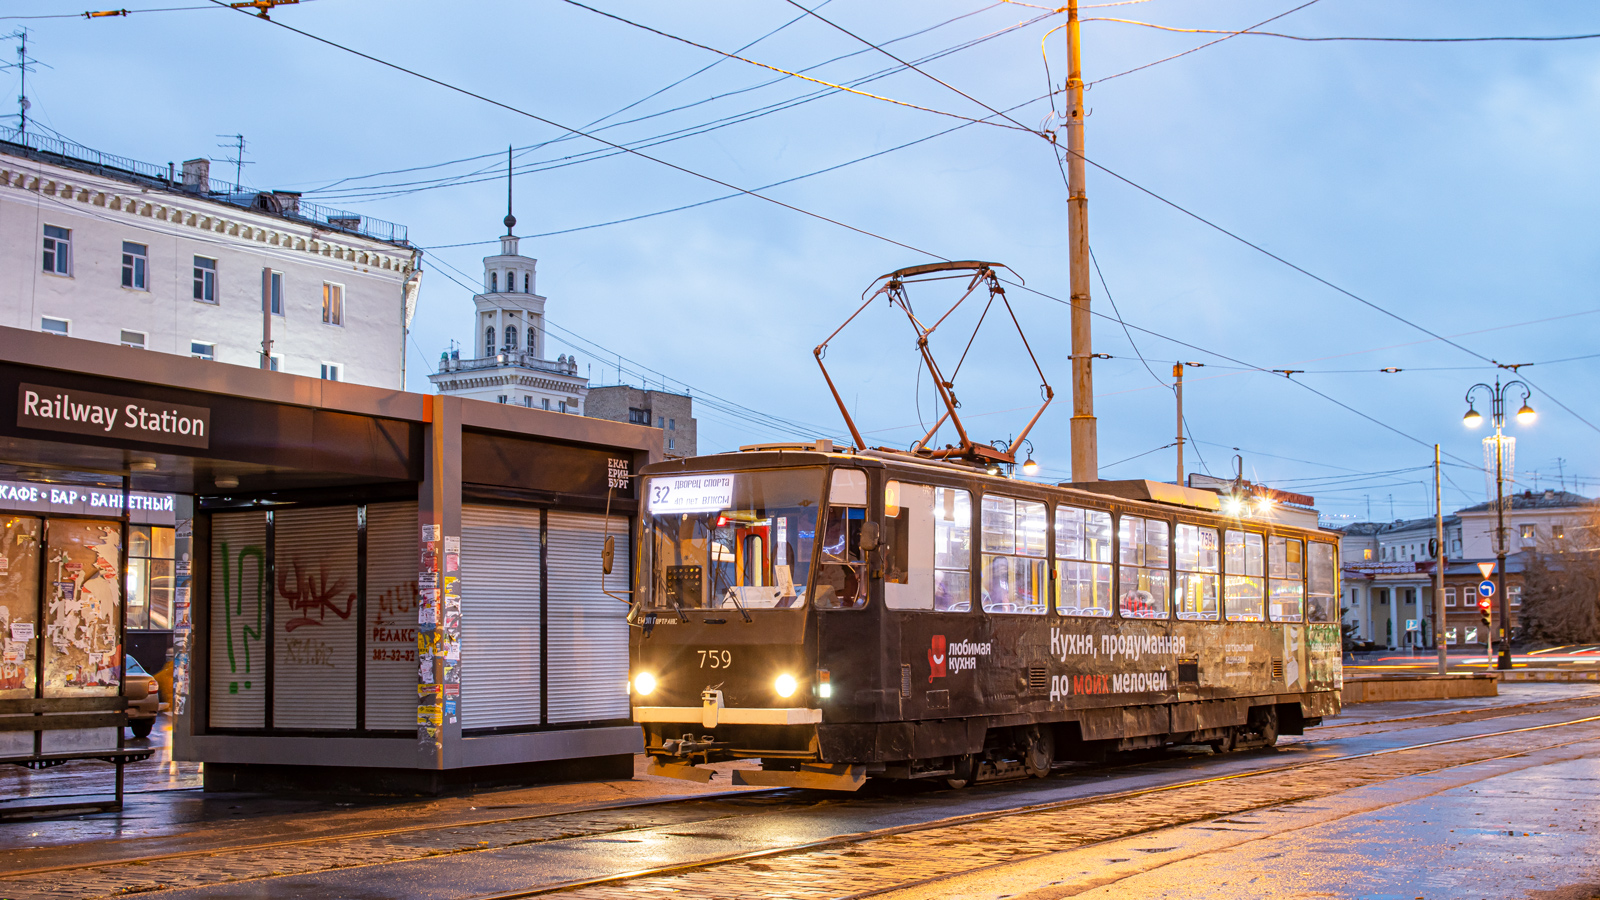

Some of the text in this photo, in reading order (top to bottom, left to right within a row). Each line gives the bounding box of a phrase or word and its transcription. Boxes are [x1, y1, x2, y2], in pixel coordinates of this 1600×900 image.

[24, 390, 205, 437] Railway Station
[607, 457, 629, 469] ЕКАТ
[607, 468, 629, 479] ЕРИН
[0, 485, 38, 502] КАФЕ
[50, 489, 77, 505] БАР
[652, 485, 671, 505] 32
[1200, 531, 1213, 547] 759
[373, 627, 415, 642] РЕЛАКС
[948, 638, 992, 655] любимая
[1050, 627, 1186, 662] Кухня, продуманная
[697, 650, 732, 669] 759
[948, 656, 976, 674] кухня
[1049, 665, 1168, 702] до моих мелочей
